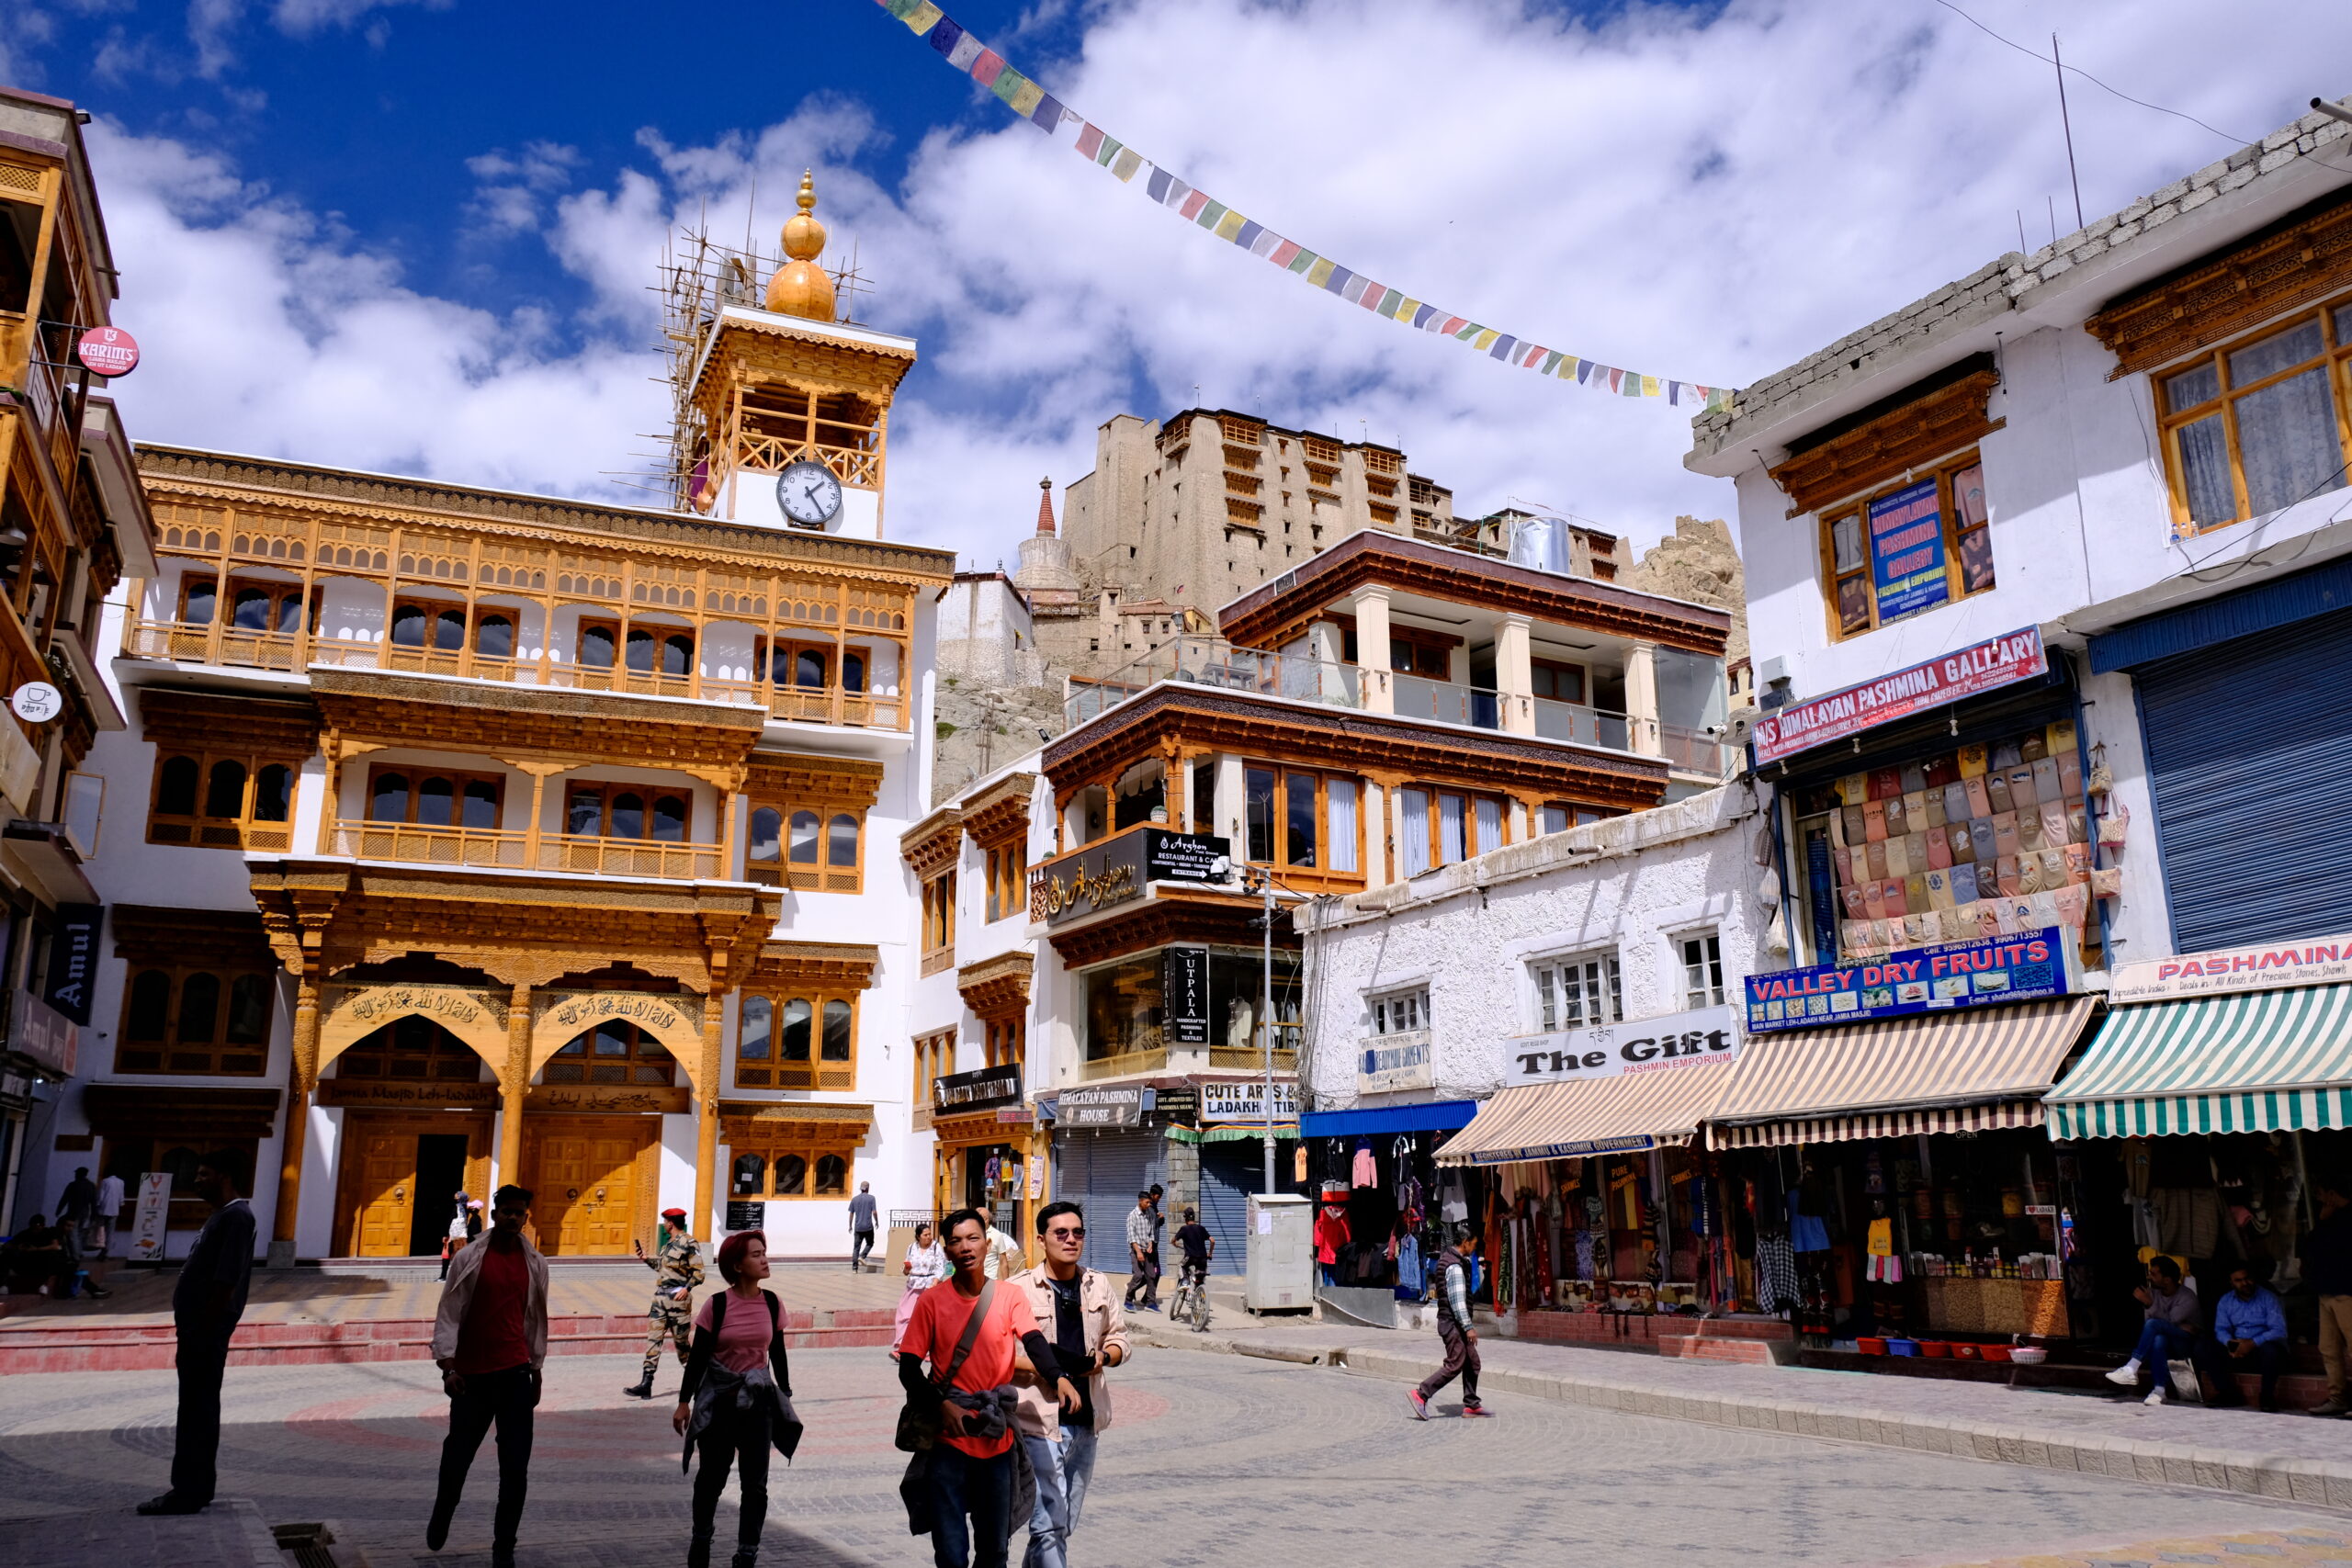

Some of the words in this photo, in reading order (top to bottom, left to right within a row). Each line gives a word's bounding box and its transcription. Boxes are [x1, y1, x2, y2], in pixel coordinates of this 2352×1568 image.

[80, 343, 134, 361] KARIM'S
[1878, 520, 1938, 558] PASHMINA
[1888, 546, 1933, 579] GALLERY
[1911, 566, 1946, 586] EMPORIUM
[1880, 596, 1904, 608] REGISTERED
[1910, 589, 1925, 598] JAMMU
[1899, 596, 1927, 610] GOVERNMENT
[1881, 616, 1894, 625] MAIN
[1894, 610, 1917, 623] MARKET
[1917, 605, 1928, 615] LEH
[1755, 721, 1777, 747] M/S
[1778, 694, 1856, 739] HIMALAYAN
[1857, 666, 1939, 712] PASHMINA
[1944, 631, 2035, 682] GALLARY
[1170, 836, 1207, 852] Arghon
[1158, 852, 1197, 862] RESTAURANT
[54, 922, 91, 1008] Amul
[1753, 970, 1854, 1001] VALLEY
[1863, 959, 1922, 987] DRY
[1931, 941, 2050, 977] FRUITS
[1186, 959, 1196, 1017] UTPALA
[2114, 986, 2146, 997] Incredible
[2179, 980, 2199, 990] Deals
[2215, 976, 2225, 987] All
[2227, 976, 2246, 986] Kinds
[2249, 973, 2259, 983] of
[2262, 971, 2291, 981] Precious
[2322, 964, 2346, 976] Shawls
[1969, 995, 1990, 1005] E-mail:
[22, 1000, 51, 1053] Amul
[1751, 1021, 1765, 1031] MAIN
[1764, 1020, 1785, 1029] MARKET
[1786, 1016, 1818, 1026] LEH-LADAKH
[1818, 1014, 1834, 1022] NEAR
[1834, 1012, 1850, 1021] JAMIA
[1851, 1010, 1871, 1020] MASJID
[1516, 1050, 1607, 1074] The
[1621, 1030, 1731, 1061] Gift
[1623, 1061, 1669, 1074] PASHMIN
[1673, 1053, 1732, 1068] EMPORIUM
[331, 1087, 368, 1100] Jamia
[372, 1088, 413, 1102] Masjid
[1058, 1092, 1099, 1105] HIMALAYAN
[1099, 1090, 1138, 1104] PASHMINA
[1205, 1085, 1240, 1099] CUTE
[1247, 1085, 1282, 1099] ARS
[1080, 1110, 1109, 1122] HOUSE
[1955, 1131, 1978, 1139] OPEN
[1475, 1148, 1515, 1162] REGISTERED
[1523, 1145, 1551, 1157] JAMMU
[1552, 1146, 1558, 1156] &
[1558, 1142, 1593, 1154] KASHMIR
[1593, 1135, 1647, 1152] GOVERNMENT
[1611, 1165, 1628, 1178] PURE
[1670, 1169, 1692, 1185] SHAWLS
[1561, 1179, 1581, 1193] SHAWLS
[1611, 1172, 1637, 1191] PASHMINA
